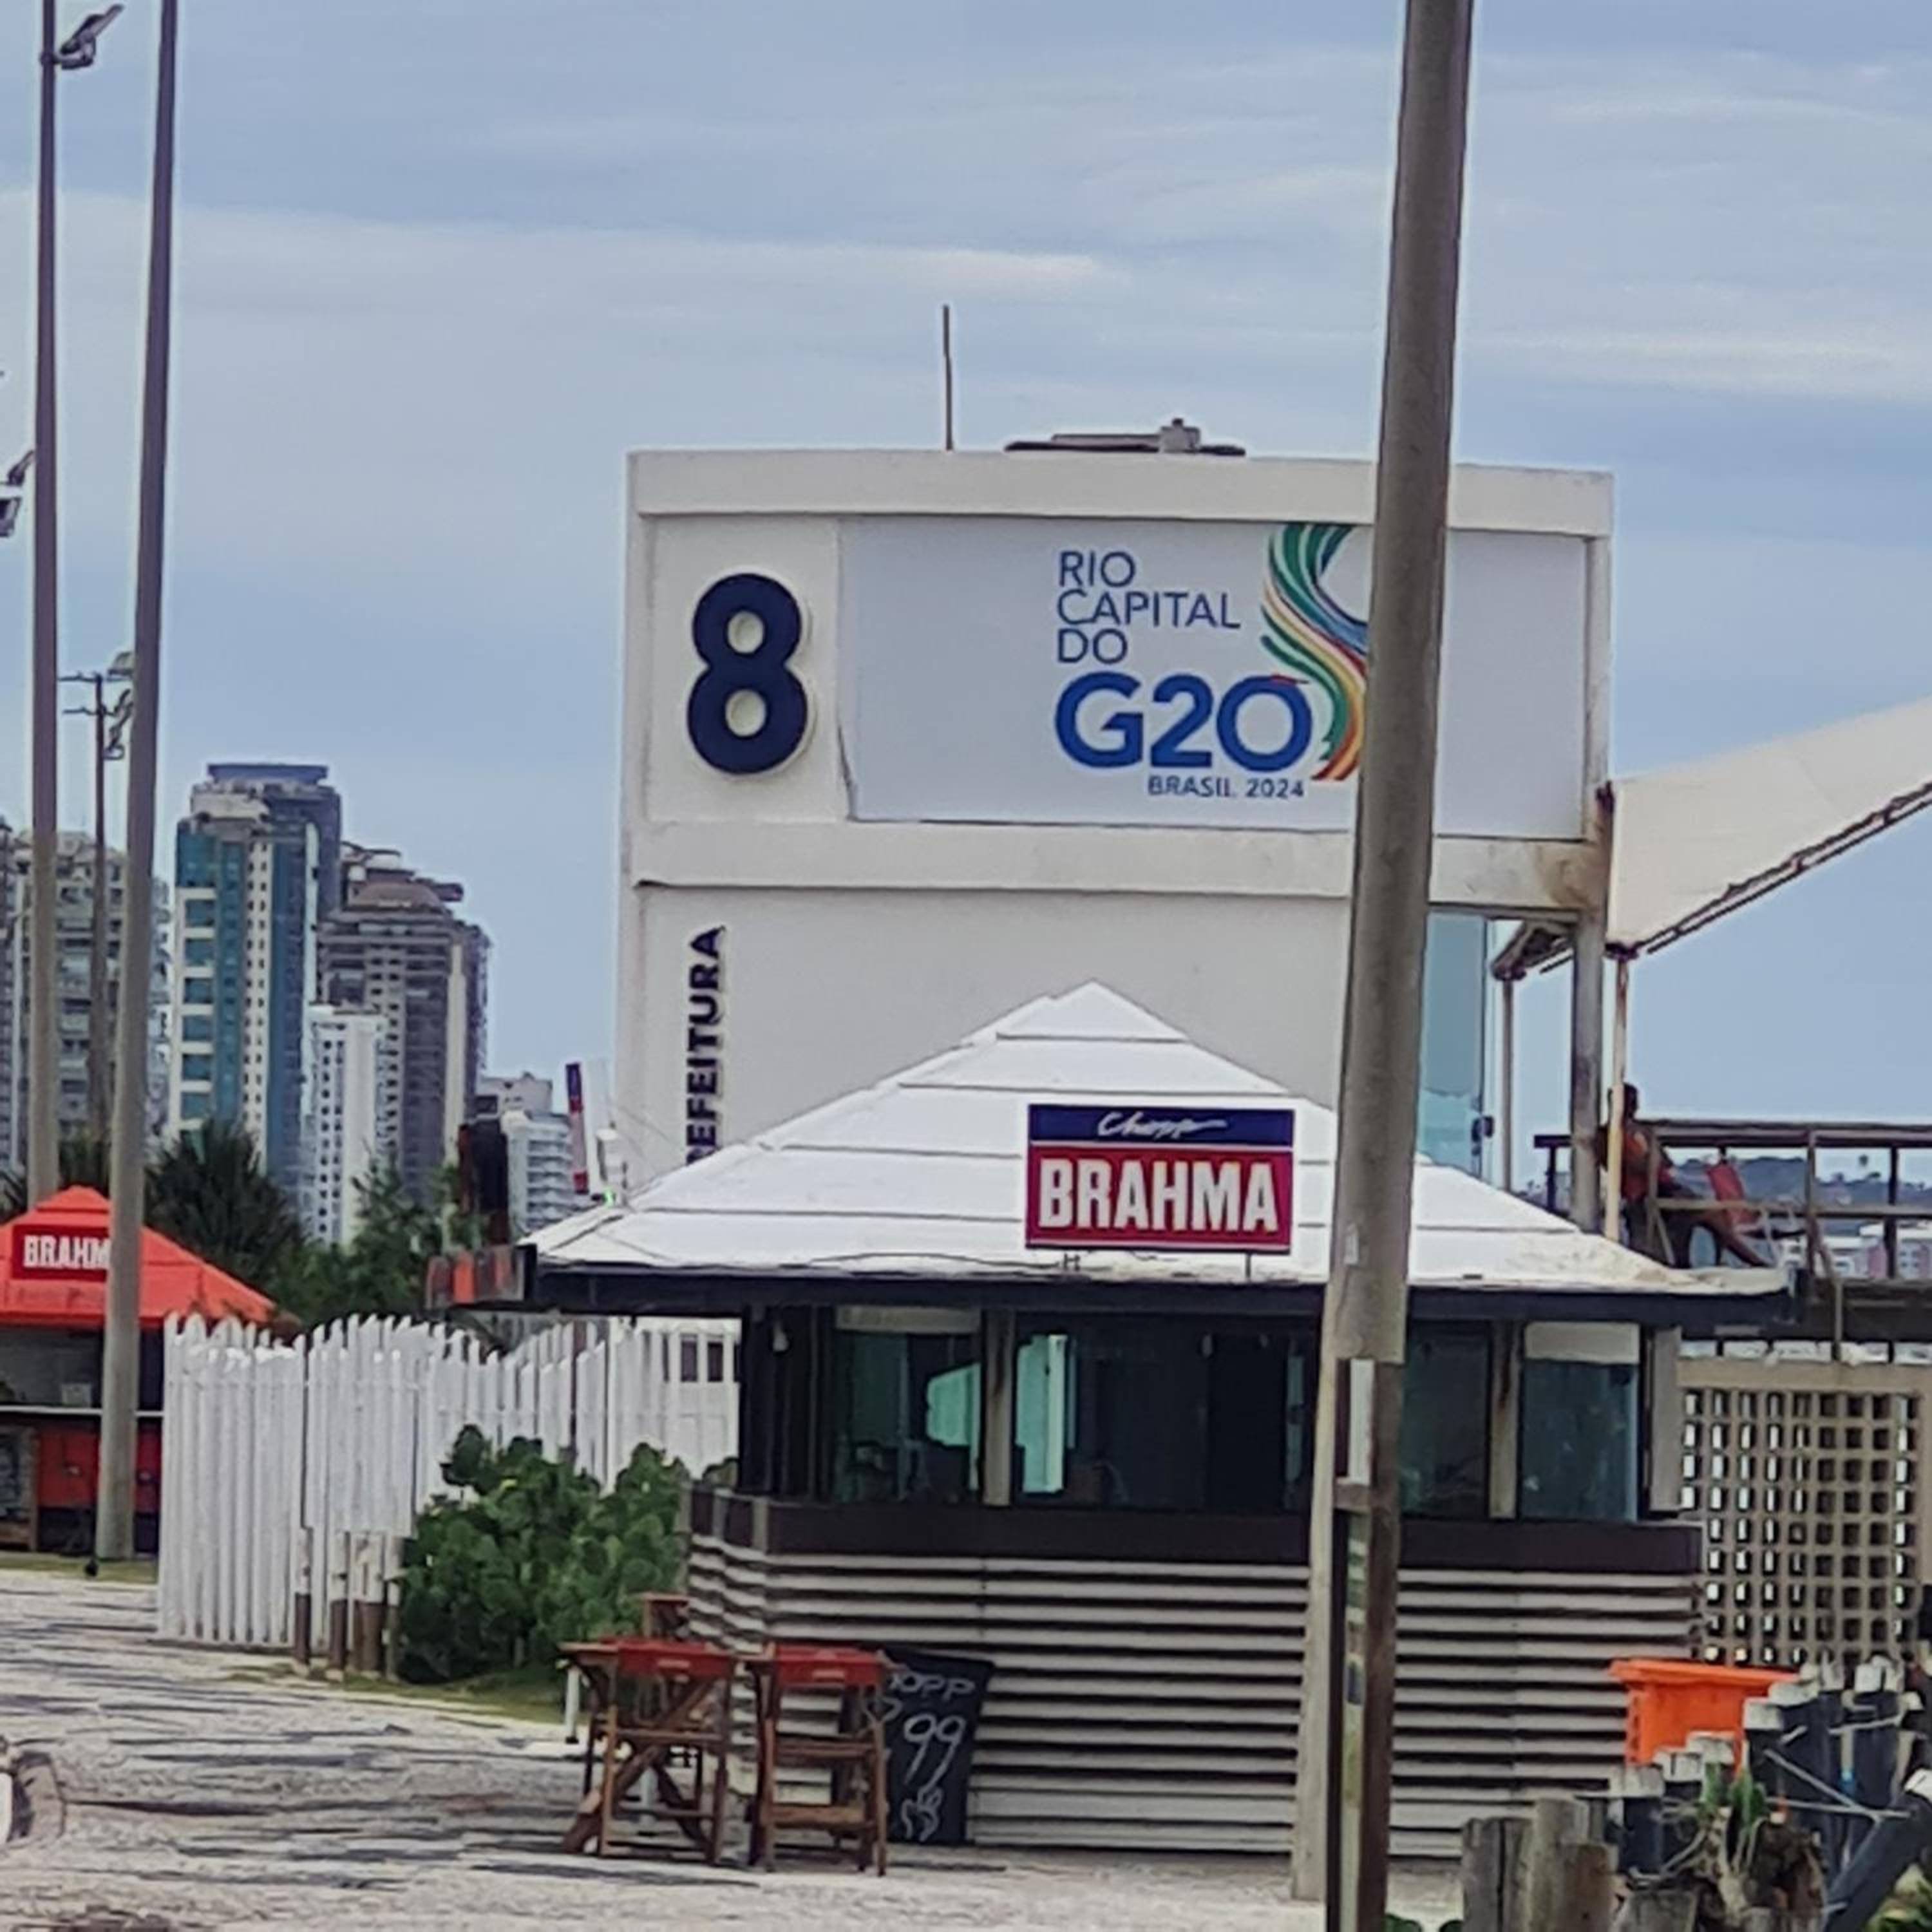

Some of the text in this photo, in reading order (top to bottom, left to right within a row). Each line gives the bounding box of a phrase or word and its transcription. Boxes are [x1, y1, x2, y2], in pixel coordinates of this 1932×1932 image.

[1059, 551, 1136, 587] RIO
[1057, 589, 1241, 629] CAPITAL
[1057, 629, 1128, 665] DO
[687, 573, 808, 774] 8
[1055, 671, 1312, 773] G20
[1148, 776, 1304, 798] BRASIL 2024
[1038, 1157, 1278, 1232] BRAHMA
[23, 1234, 112, 1269] BRAHM
